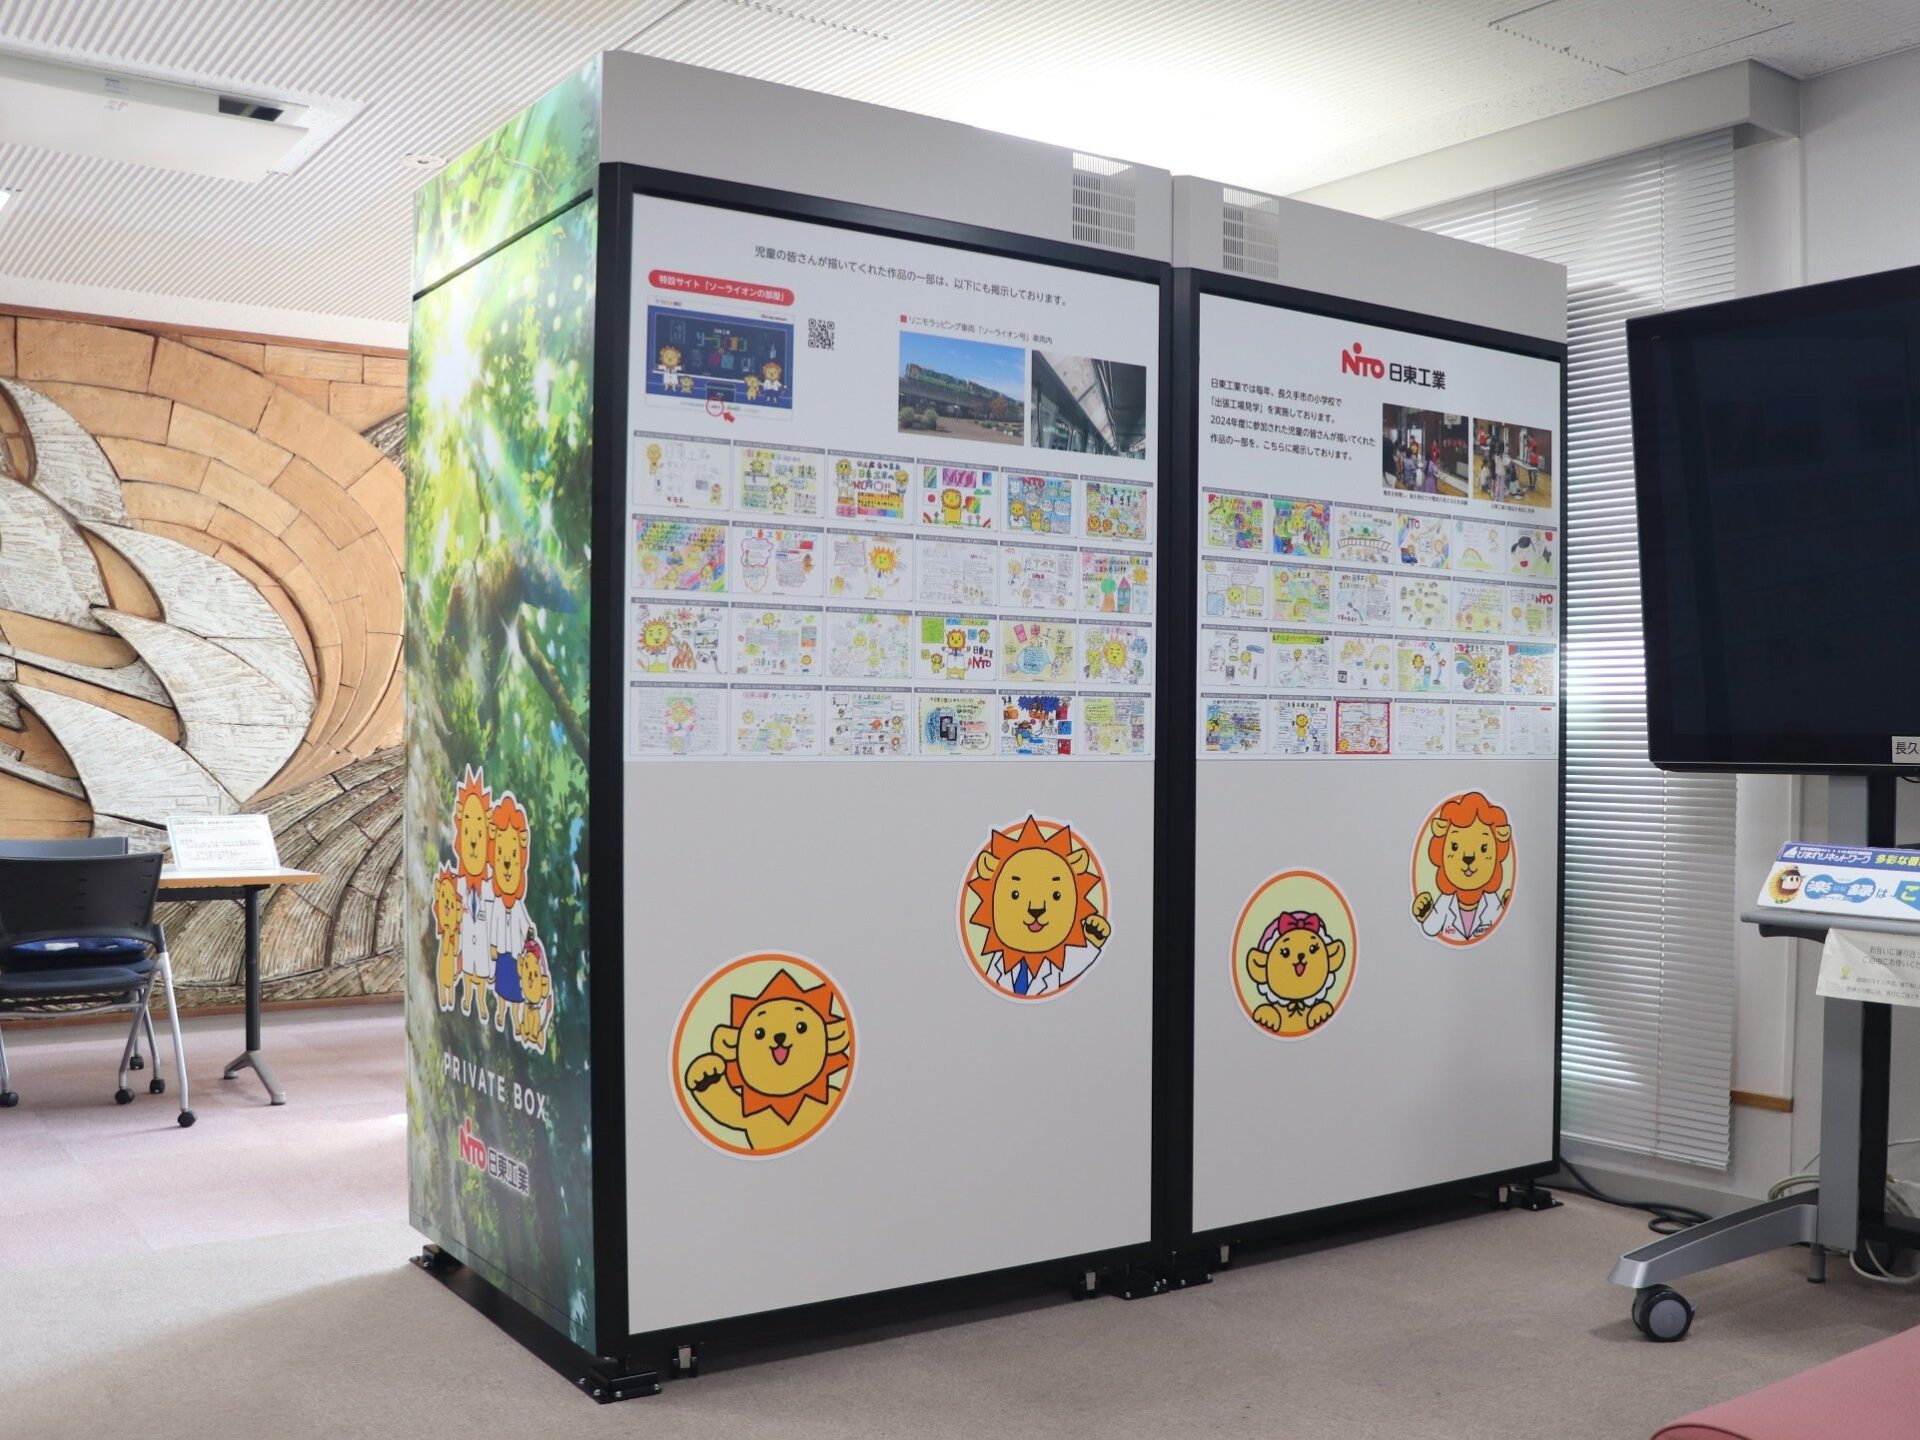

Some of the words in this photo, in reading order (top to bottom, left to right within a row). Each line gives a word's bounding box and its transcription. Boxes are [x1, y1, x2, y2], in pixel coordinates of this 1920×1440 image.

[755, 245, 1067, 306] 児童の皆さんが描いてくれた作品の一部は、以下にも掲示しております。
[1389, 362, 1446, 390] 日東工業
[1211, 378, 1343, 408] 日東工業では毎年、長久手市の小学校で
[1210, 415, 1376, 447] 2024年度に参加された児童の皆さんが描いてくれた
[1894, 741, 1919, 755] 長久
[1875, 854, 1920, 867] 多彩な番
[443, 1052, 506, 1103] PRIVATE
[513, 1082, 547, 1122] BOX
[488, 1150, 529, 1194] 日東工業
